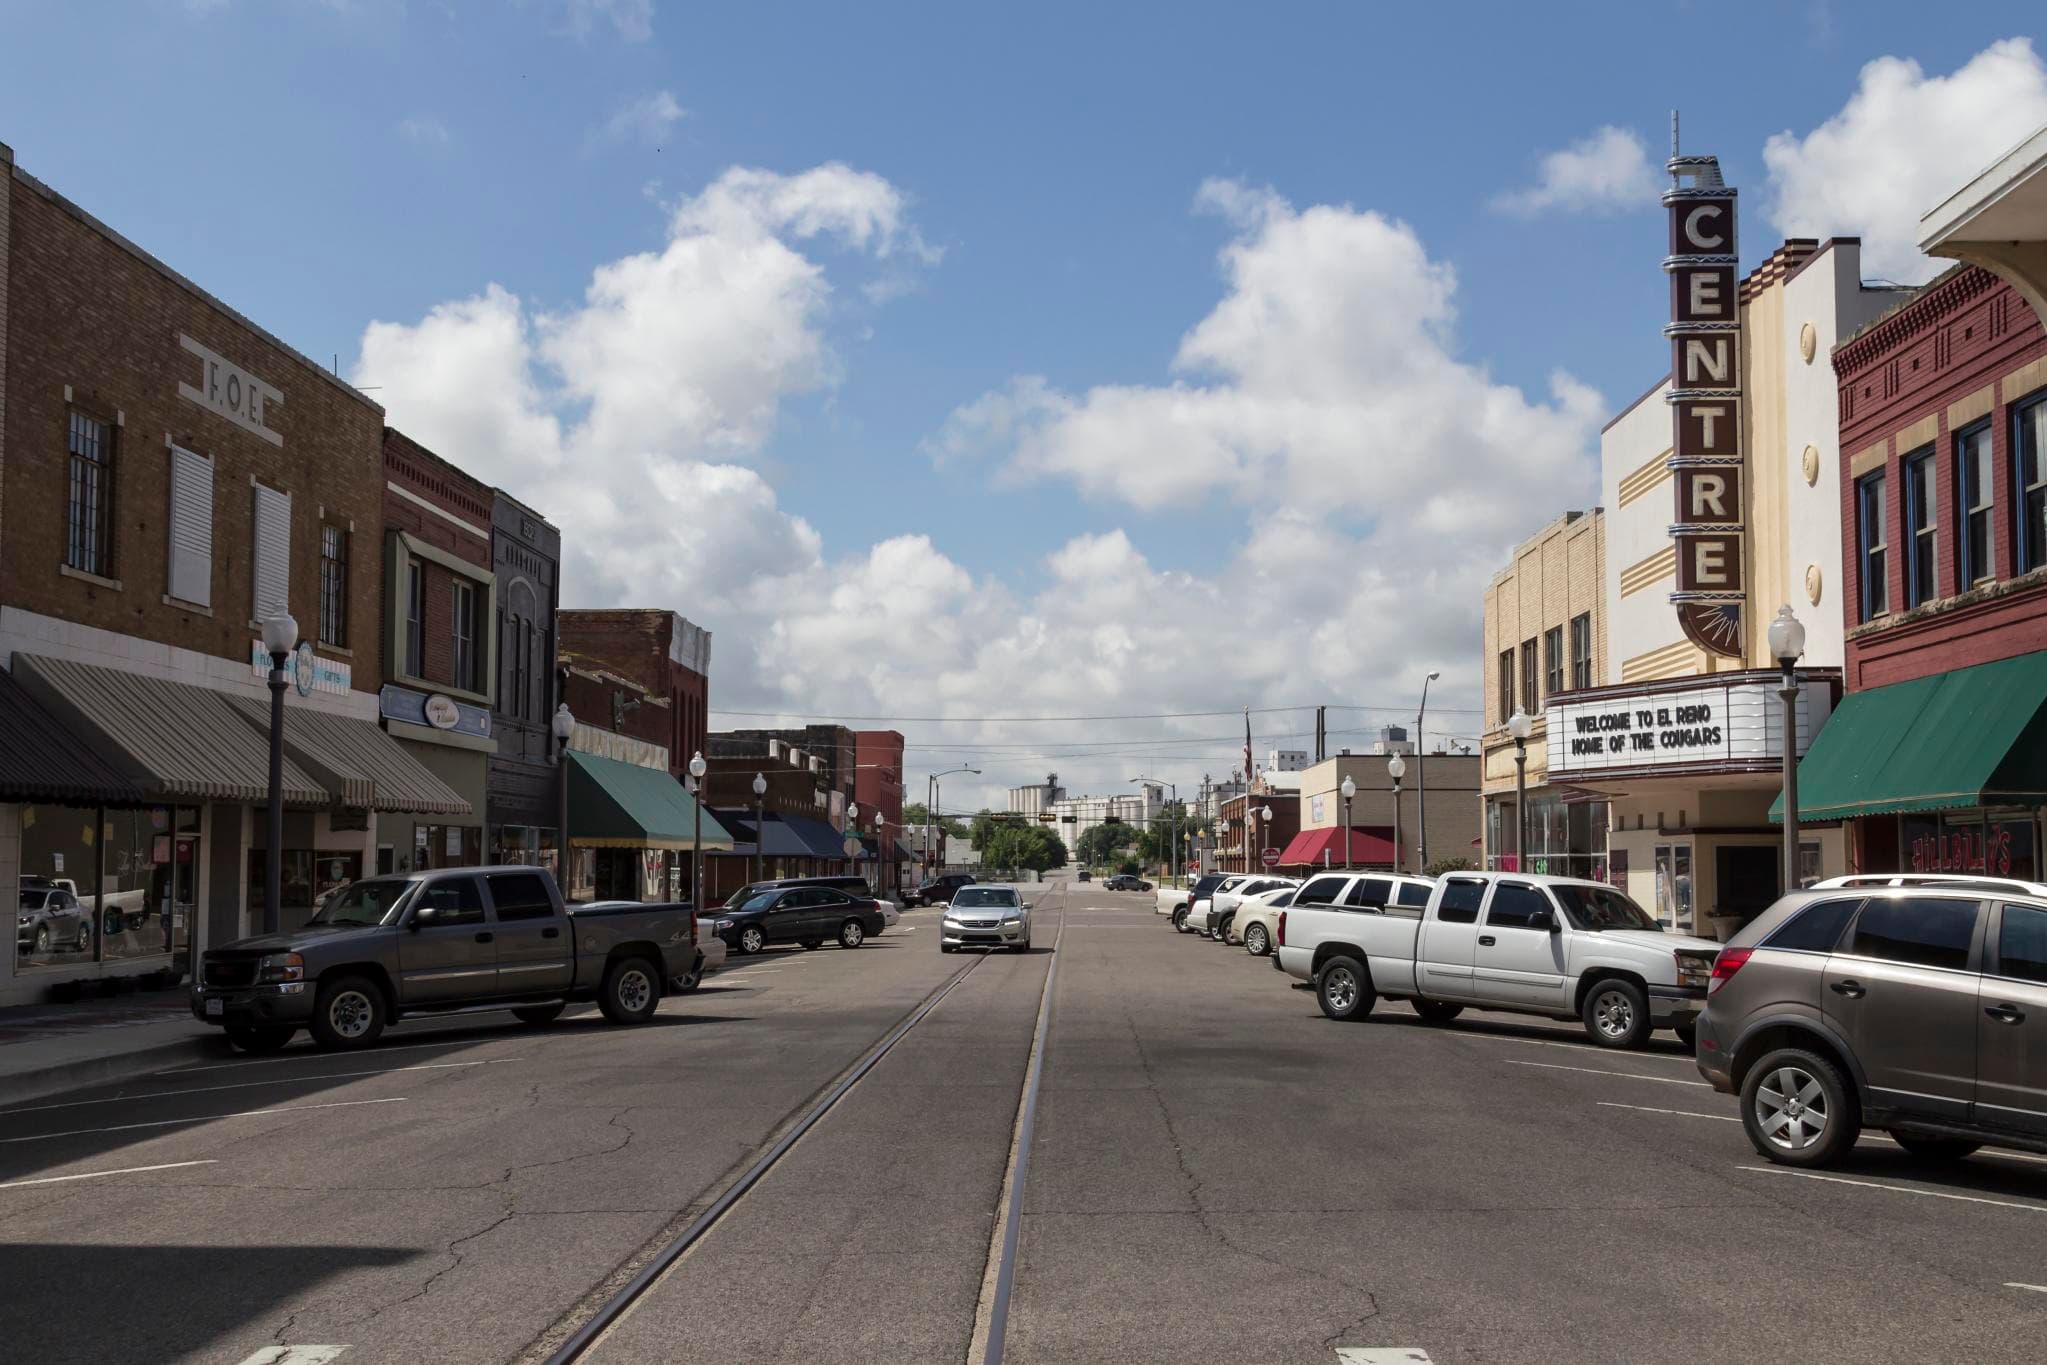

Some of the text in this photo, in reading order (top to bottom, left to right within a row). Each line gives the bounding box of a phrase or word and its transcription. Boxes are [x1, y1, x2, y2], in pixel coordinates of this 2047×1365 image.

[209, 361, 261, 426] F.O.E.
[1685, 204, 1729, 584] CENTRE
[260, 654, 290, 671] FLOS
[324, 670, 341, 684] GIFTS
[1575, 704, 1711, 733] WELCOME TO EL RENO
[1572, 727, 1721, 756] HOME OF THE COUGARS
